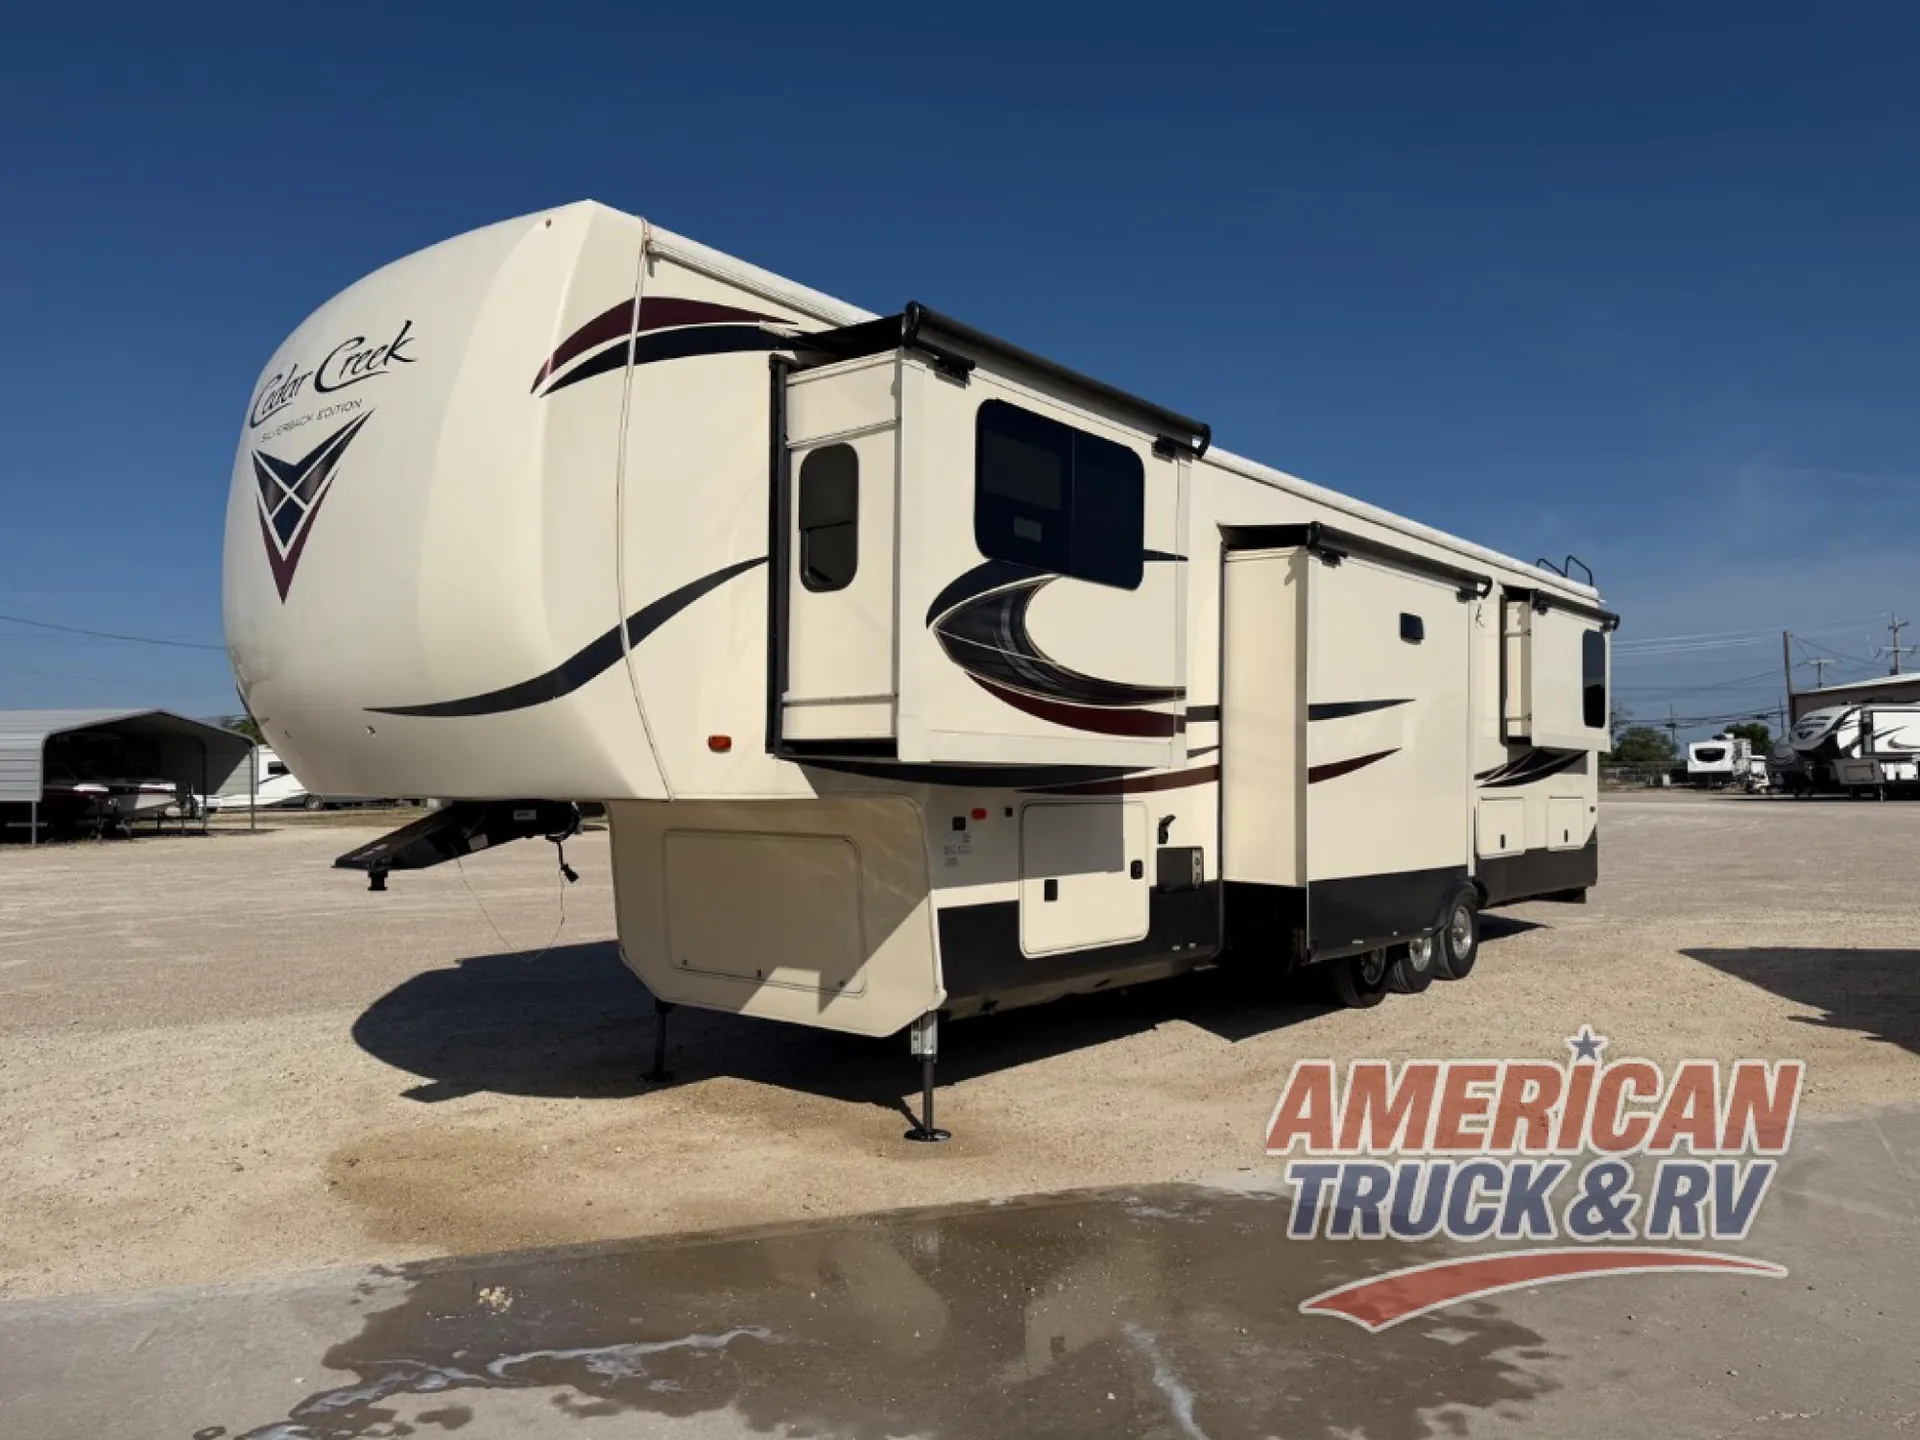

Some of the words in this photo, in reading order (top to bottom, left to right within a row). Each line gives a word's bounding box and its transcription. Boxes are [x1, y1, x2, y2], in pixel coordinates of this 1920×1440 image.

[250, 363, 314, 429] Cedar
[314, 319, 419, 393] Creek
[316, 398, 363, 421] EDITION
